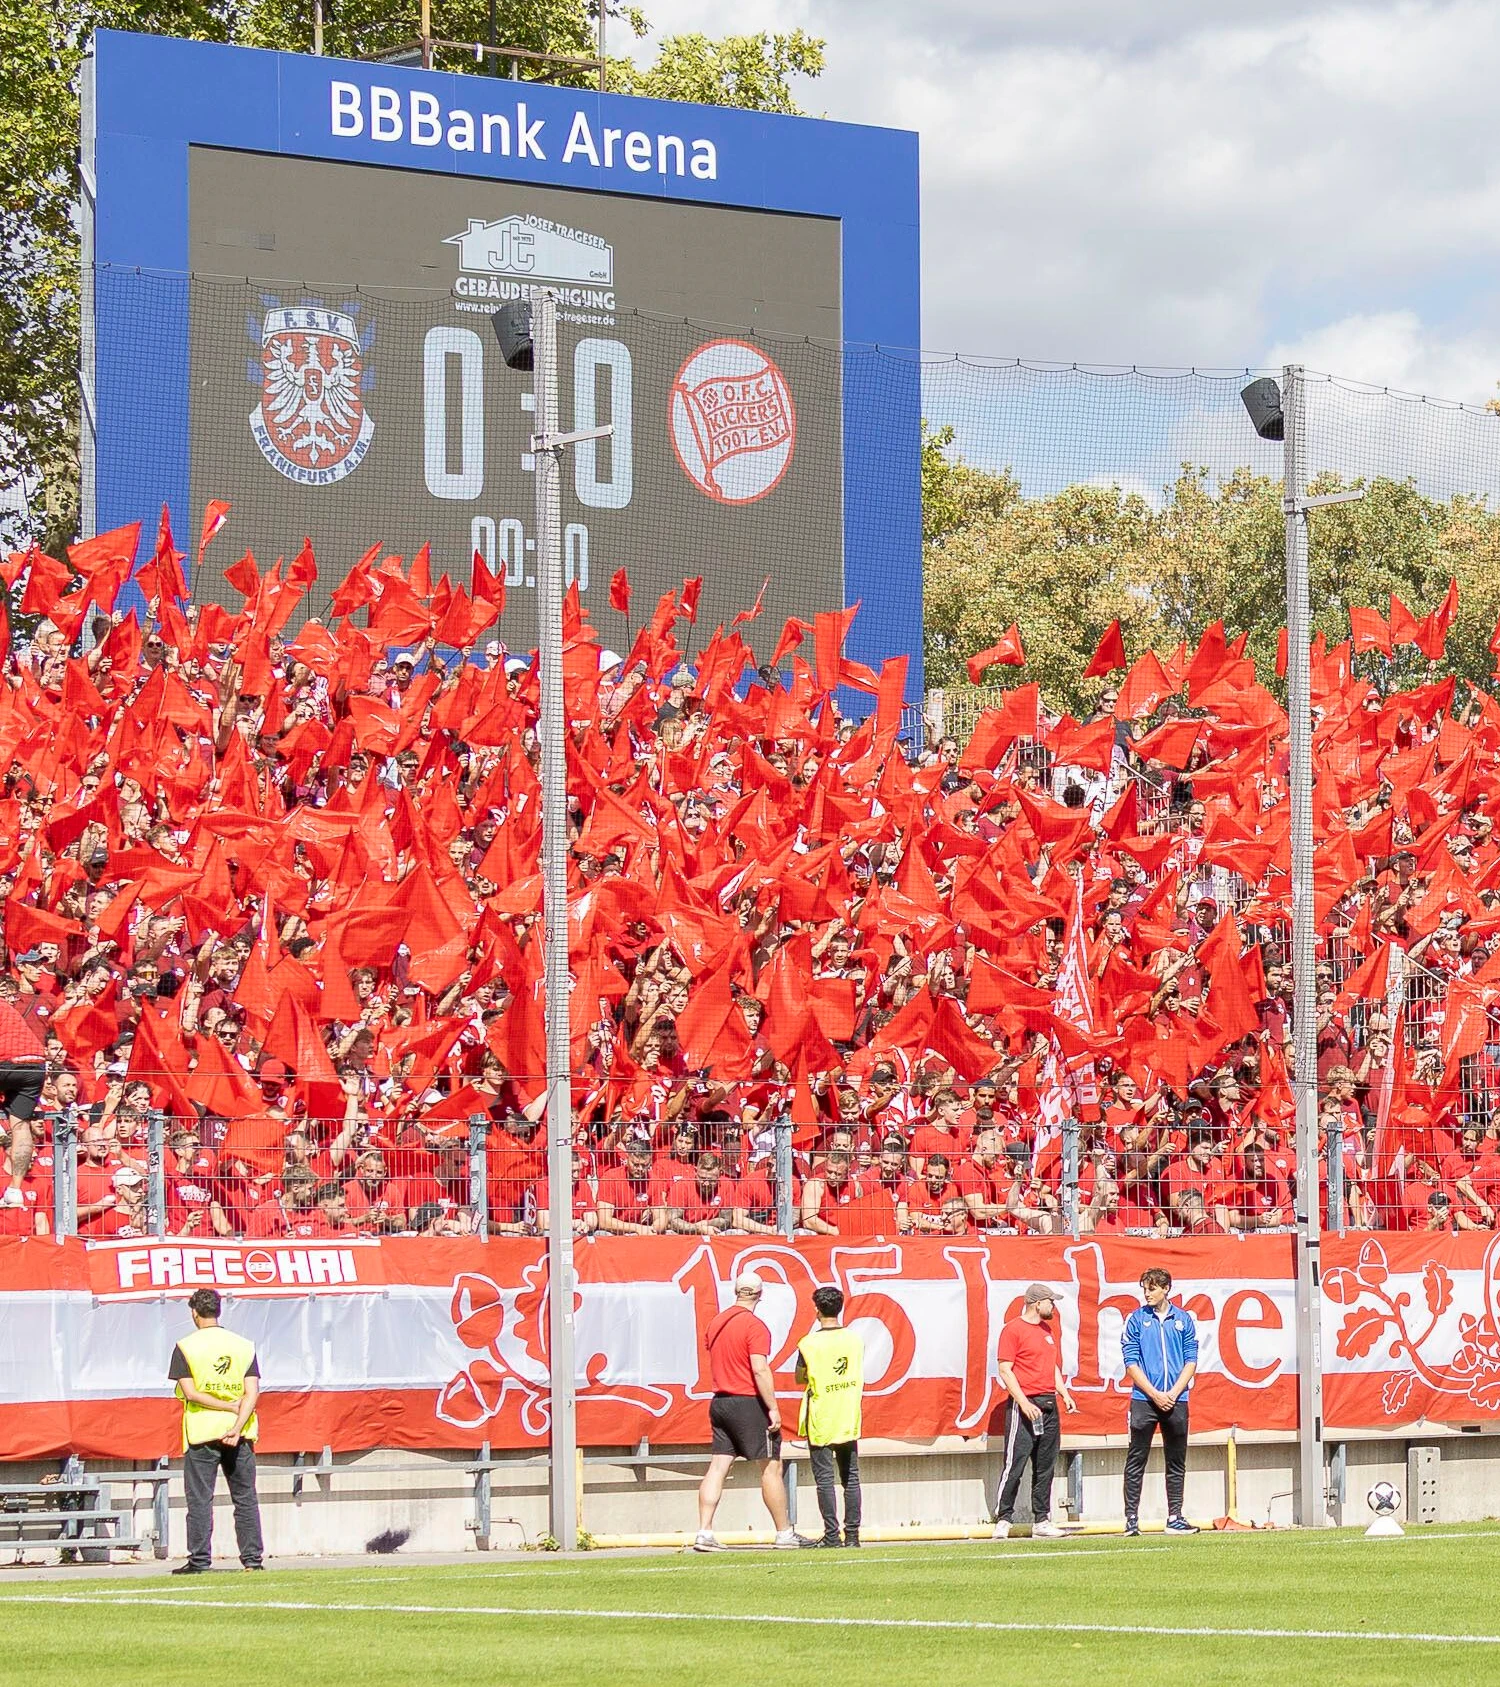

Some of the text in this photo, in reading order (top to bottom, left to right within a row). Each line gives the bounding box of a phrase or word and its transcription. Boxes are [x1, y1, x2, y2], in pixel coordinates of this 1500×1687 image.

[330, 80, 718, 180] BBBank Arena
[523, 213, 605, 250] JOSEF TRAGESER
[424, 326, 484, 500] 0
[574, 338, 633, 509] 0
[708, 399, 779, 433] KICKERS
[253, 424, 338, 484] FRANKFURT
[117, 1247, 358, 1289] FREE HAI
